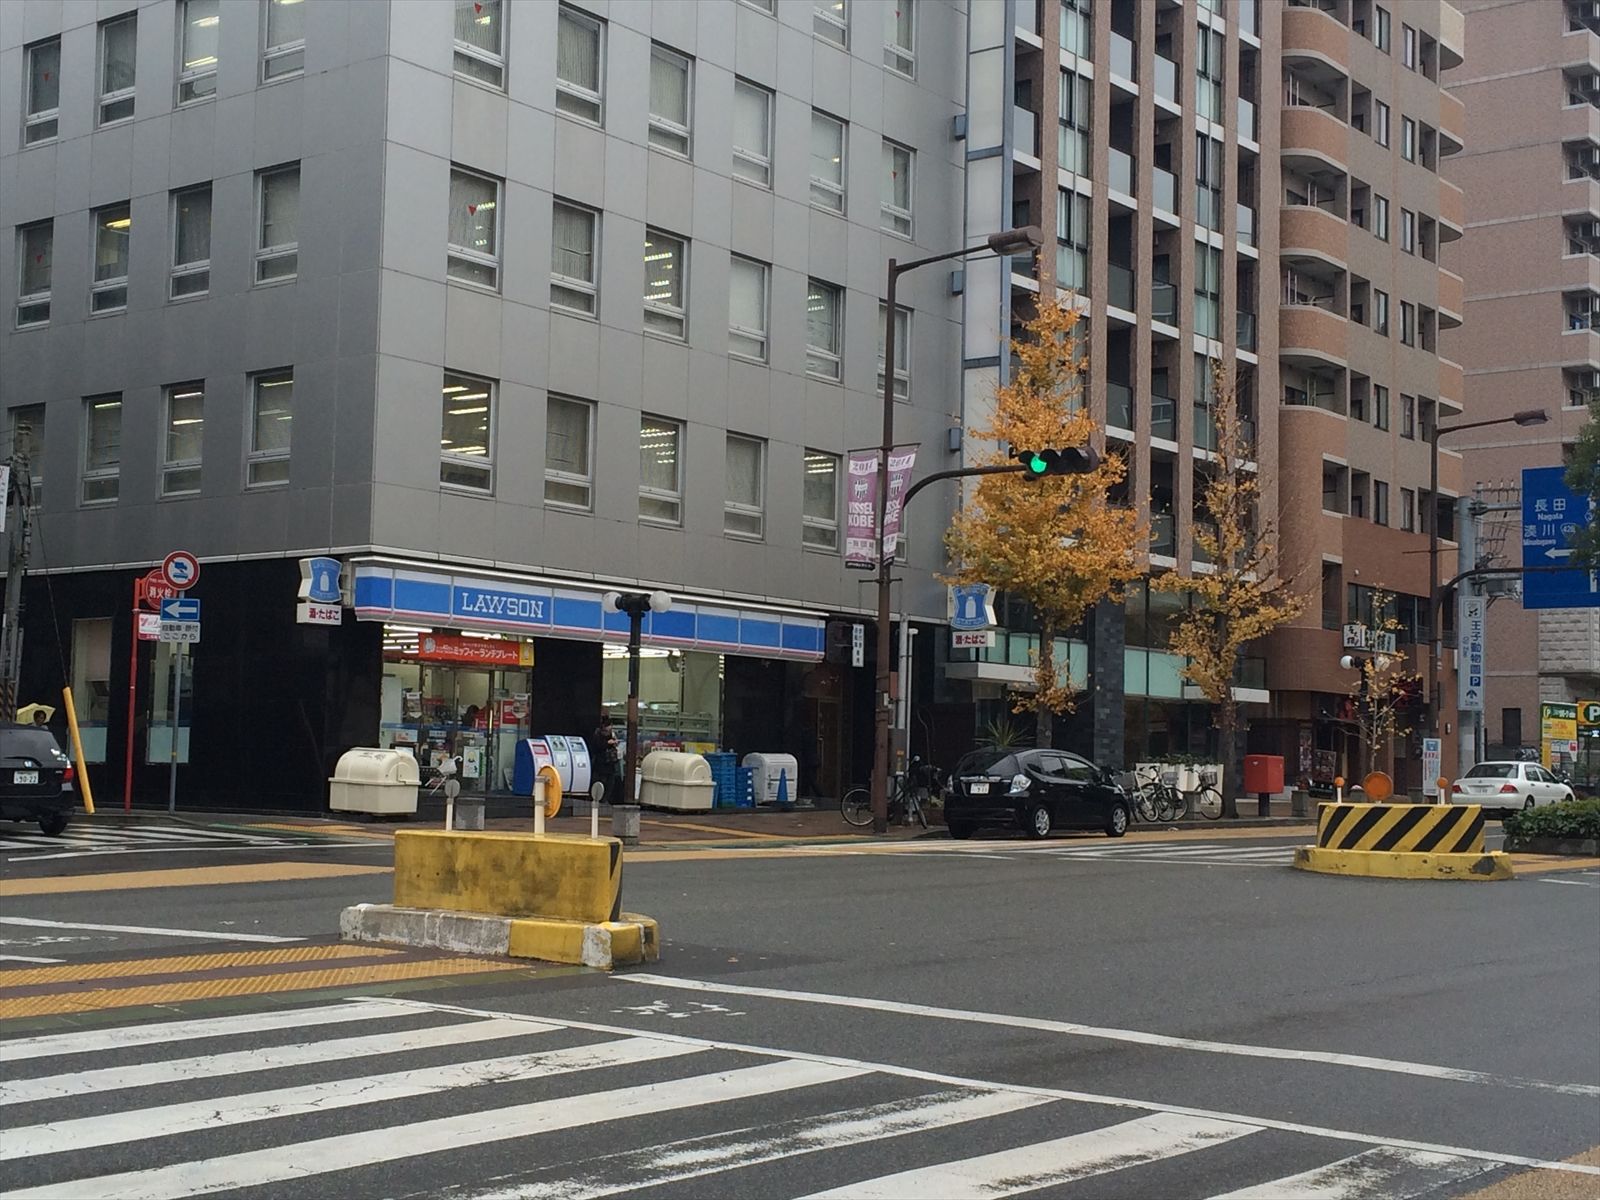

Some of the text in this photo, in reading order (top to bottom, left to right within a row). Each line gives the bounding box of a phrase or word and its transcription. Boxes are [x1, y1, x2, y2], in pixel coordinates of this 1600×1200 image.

[848, 502, 875, 514] VISSEL
[1535, 499, 1566, 512] 長田
[848, 515, 875, 528] KOBE
[1538, 513, 1563, 521] Nagata
[1524, 524, 1556, 538] 湊川
[149, 586, 173, 600] 消火栓
[462, 592, 545, 619] LAWSON
[163, 632, 197, 640] ここから
[1471, 620, 1482, 674] 王子動物園
[1589, 706, 1600, 722] P
